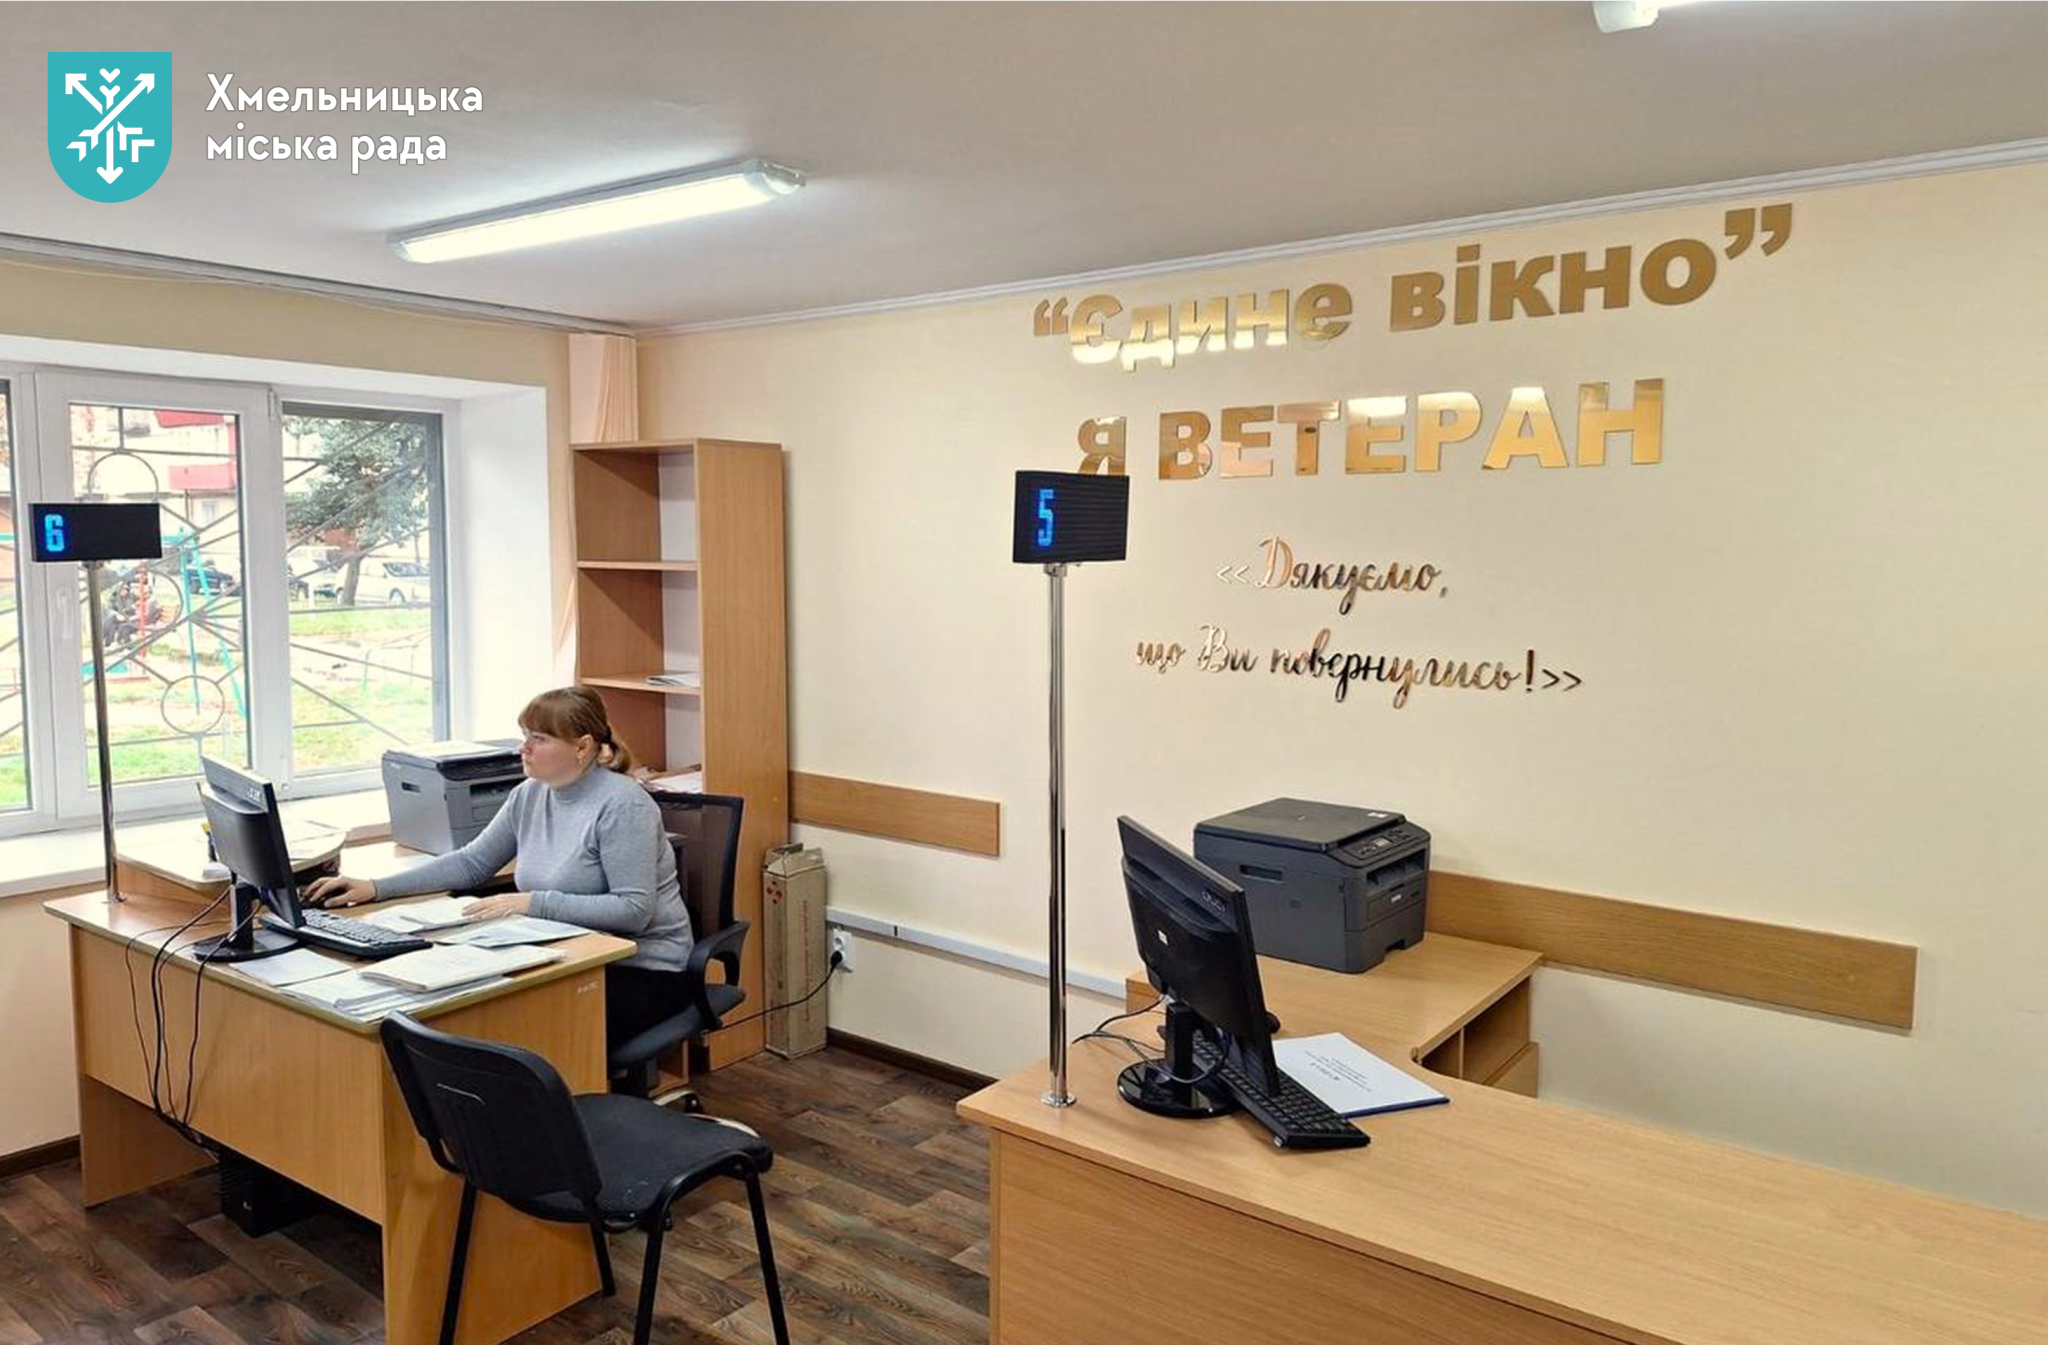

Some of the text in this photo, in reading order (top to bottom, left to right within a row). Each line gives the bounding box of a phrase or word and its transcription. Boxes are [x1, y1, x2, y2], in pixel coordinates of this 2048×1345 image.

[1077, 377, 1665, 480] Я ВЕТЕРАН
[44, 513, 65, 553] 6
[1037, 488, 1055, 547] 5
[1136, 640, 1187, 675] що
[1198, 624, 1260, 673] Ви
